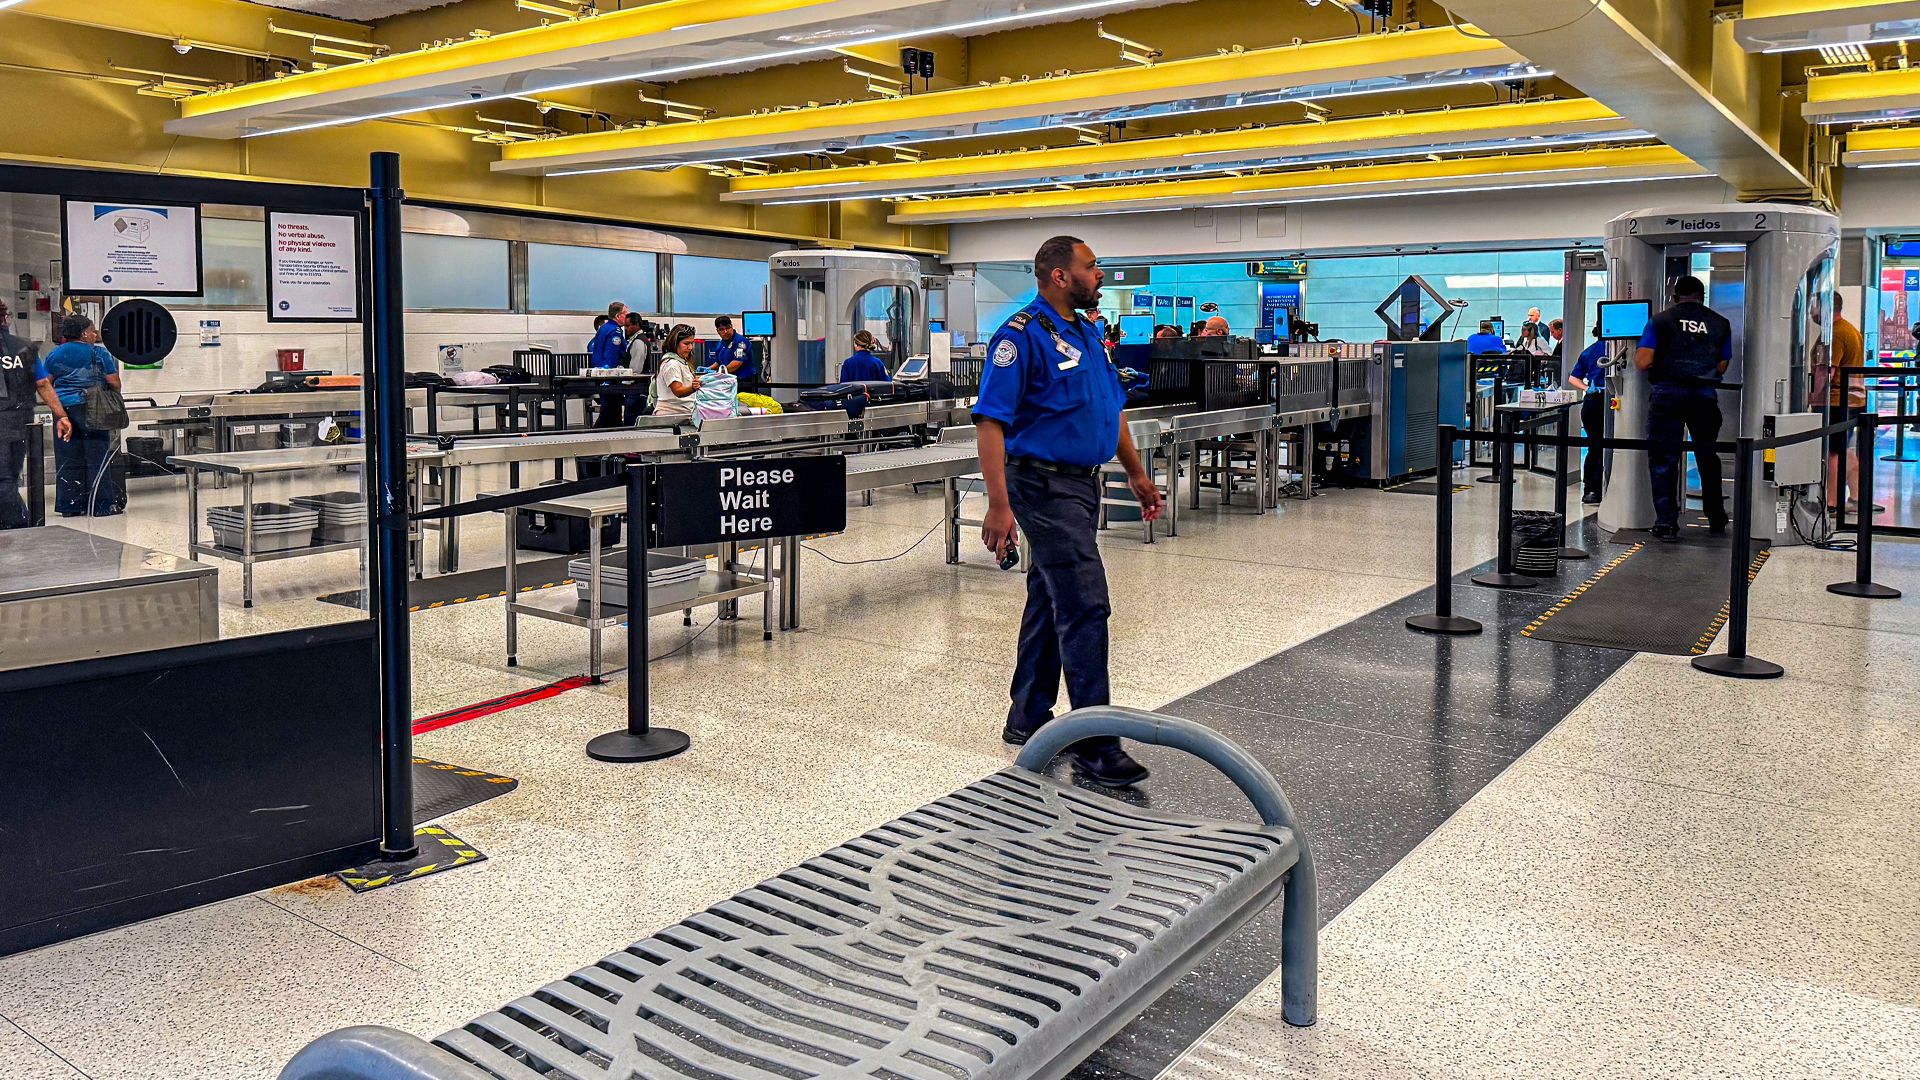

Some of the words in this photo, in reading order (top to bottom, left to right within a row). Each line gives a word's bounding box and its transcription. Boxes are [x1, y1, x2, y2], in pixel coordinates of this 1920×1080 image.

[1629, 219, 1638, 234] 2
[1680, 219, 1721, 230] leidos
[1754, 213, 1767, 229] 2
[820, 256, 825, 267] 1
[1014, 315, 1027, 324] TSA
[1679, 319, 1708, 334] TSA
[0, 355, 24, 370] SA
[1374, 353, 1382, 366] 3
[720, 467, 795, 488] Please
[719, 489, 770, 511] Wait
[720, 515, 773, 535] Here
